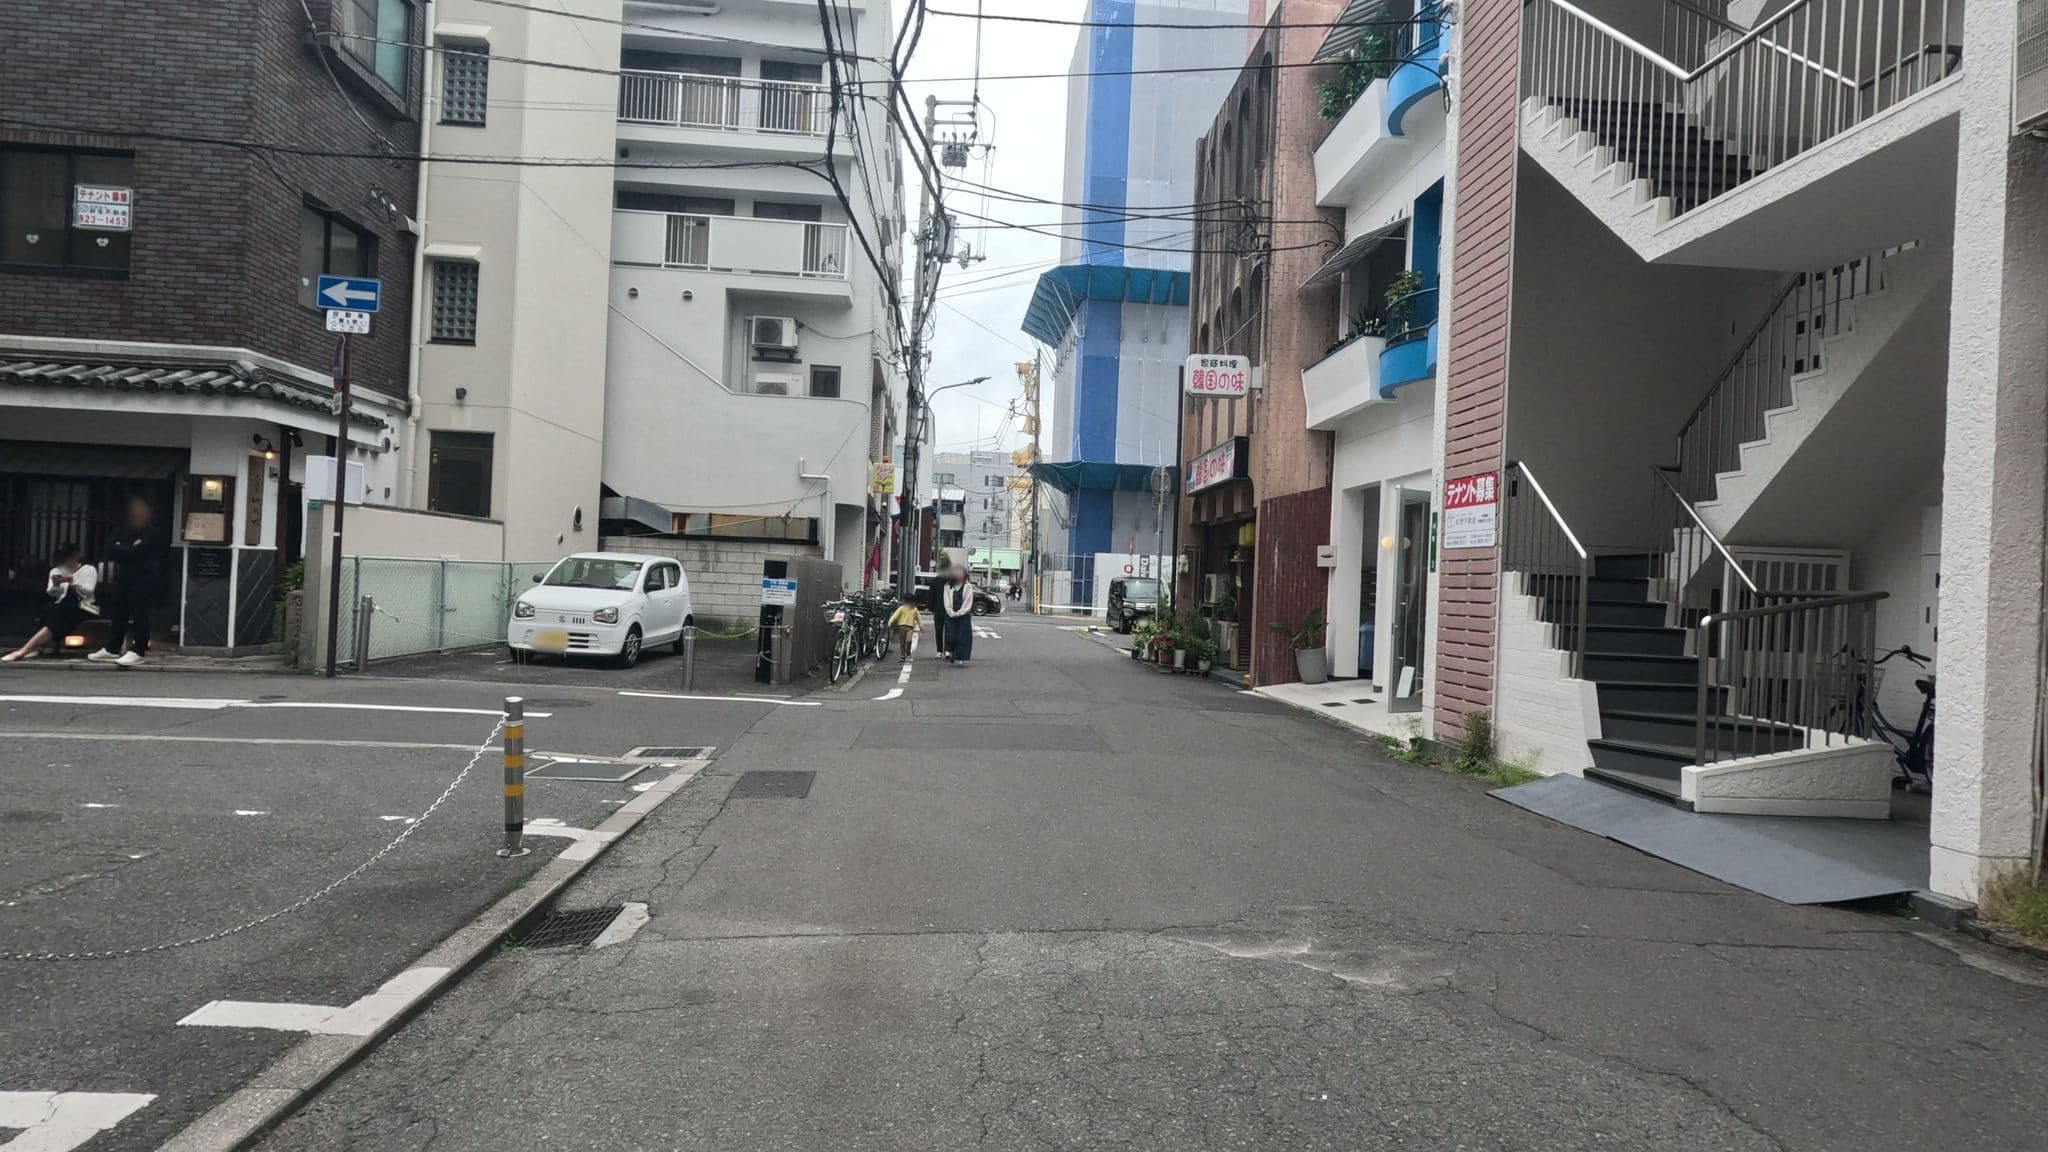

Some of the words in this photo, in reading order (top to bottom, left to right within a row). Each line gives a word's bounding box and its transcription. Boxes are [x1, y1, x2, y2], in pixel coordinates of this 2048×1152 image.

[1201, 358, 1238, 369] 家庭料理
[1193, 368, 1245, 392] 韓国の味
[1447, 475, 1495, 506] テナント募集
